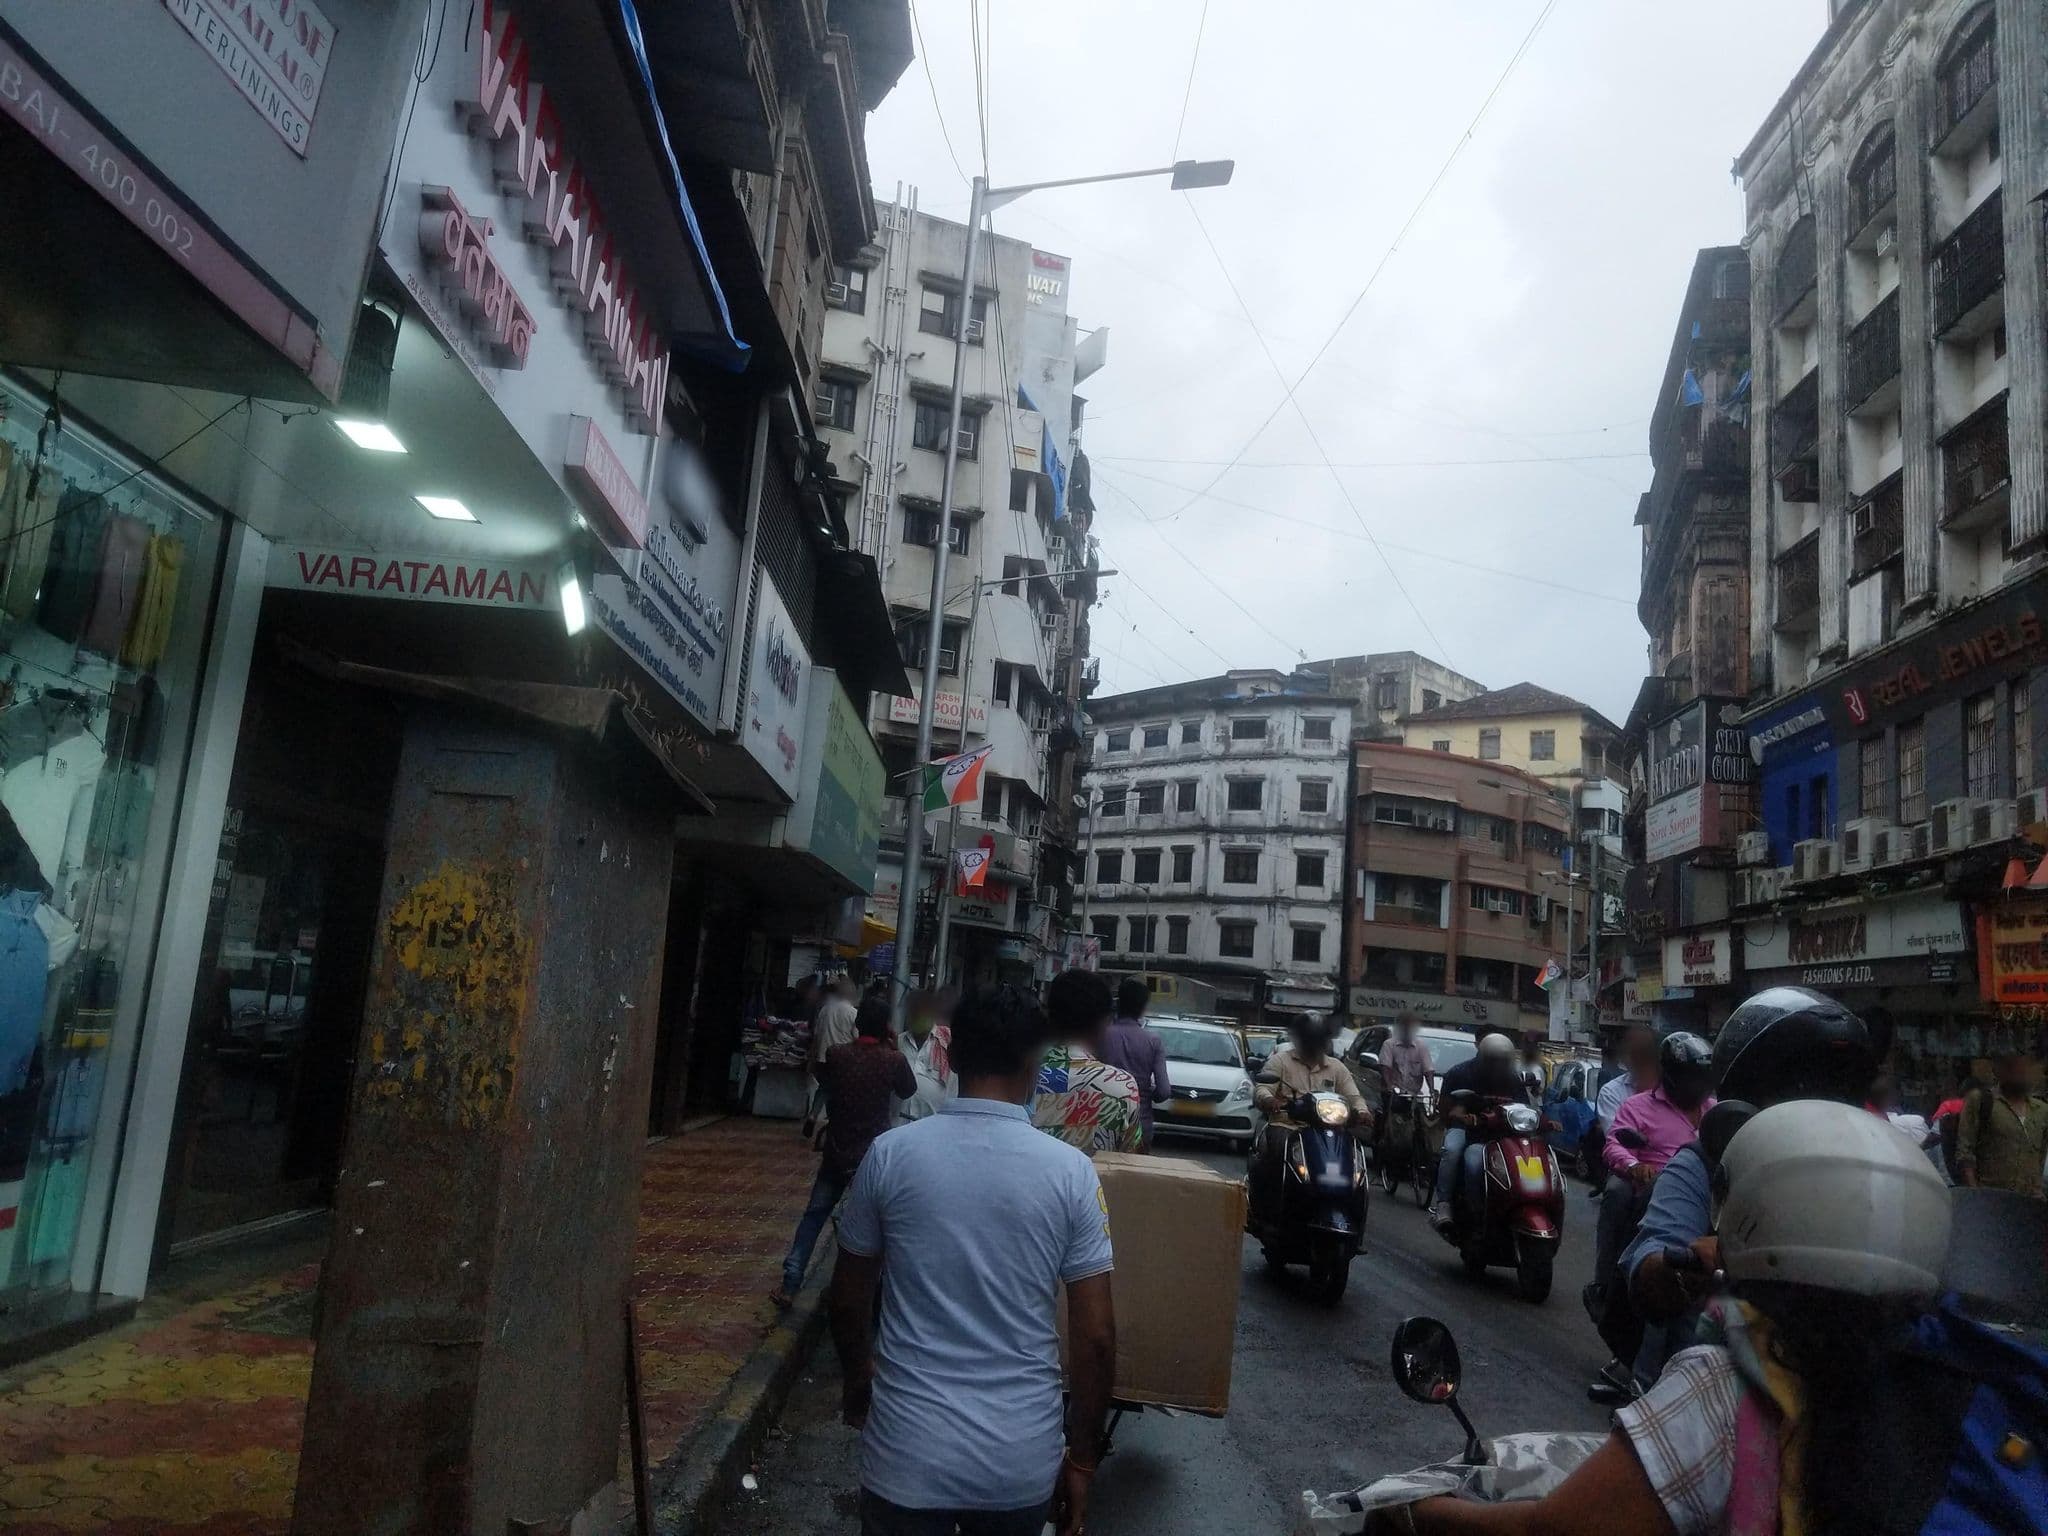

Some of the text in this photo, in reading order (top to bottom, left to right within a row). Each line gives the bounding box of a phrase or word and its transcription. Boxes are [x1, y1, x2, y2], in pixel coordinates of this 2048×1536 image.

[270, 0, 326, 67] USE
[80, 144, 136, 206] 400
[145, 199, 194, 259] 002
[297, 552, 547, 604] VARATAMAN
[1936, 611, 2042, 682] JEWELS
[894, 697, 985, 721] ANNPOONA
[936, 692, 960, 703] ARSH
[935, 716, 961, 726] STAURA
[1715, 728, 1745, 754] SKY
[1802, 965, 1875, 985] FASHIONS P.LTD.
